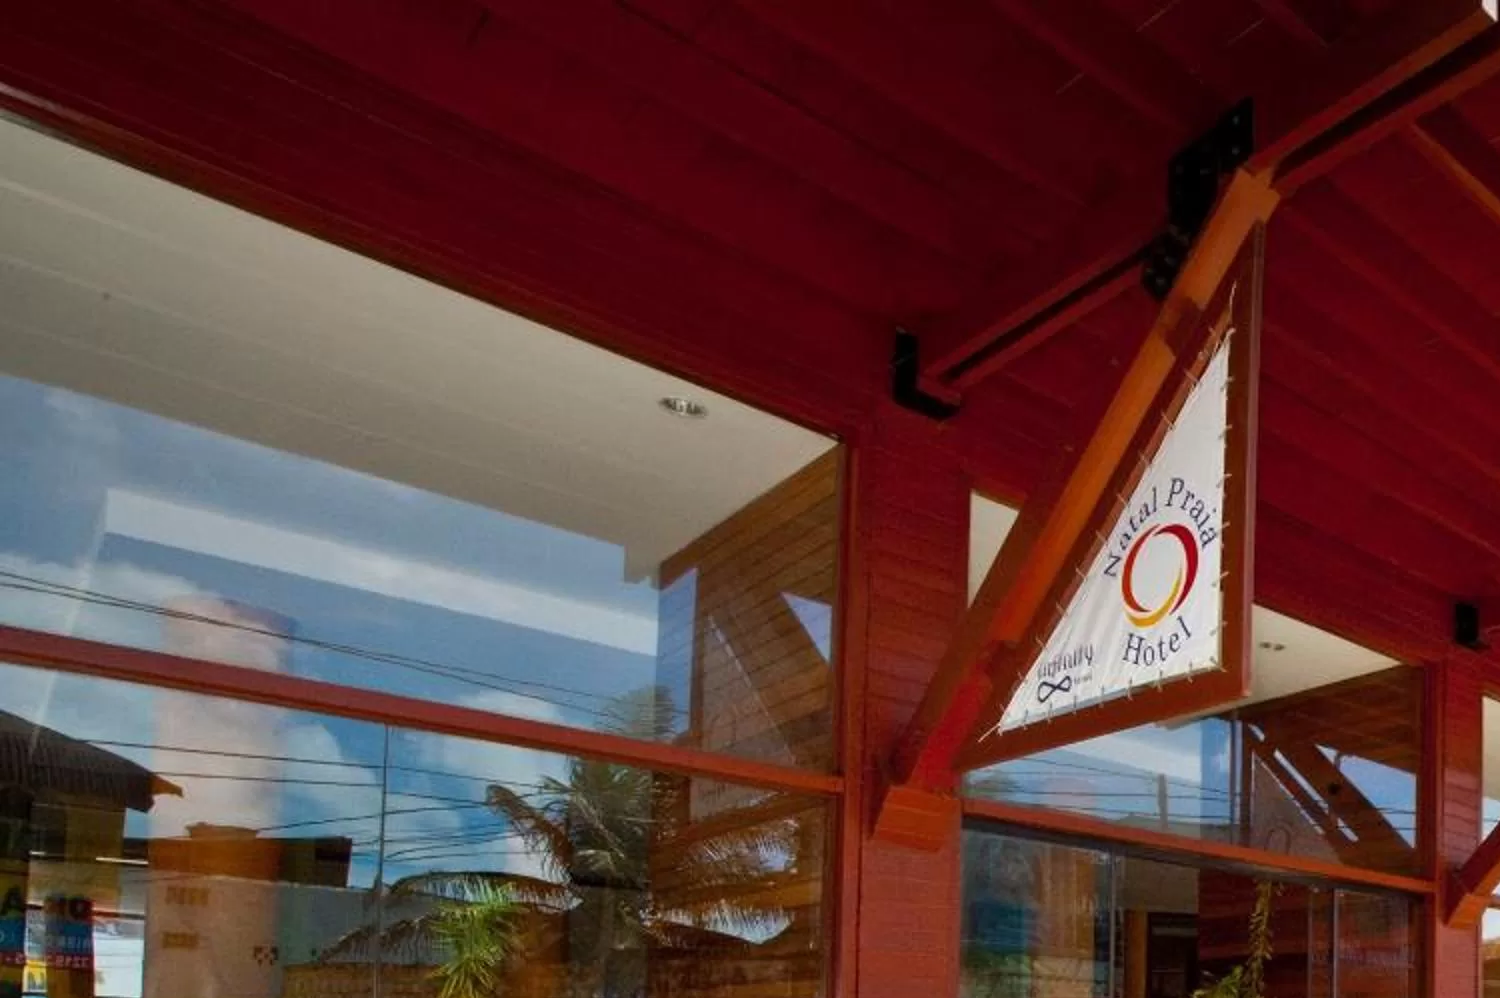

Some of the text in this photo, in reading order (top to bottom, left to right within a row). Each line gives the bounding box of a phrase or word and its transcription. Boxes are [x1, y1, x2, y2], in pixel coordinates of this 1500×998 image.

[1104, 477, 1217, 577] Natal Praia
[1122, 616, 1192, 666] Hotel
